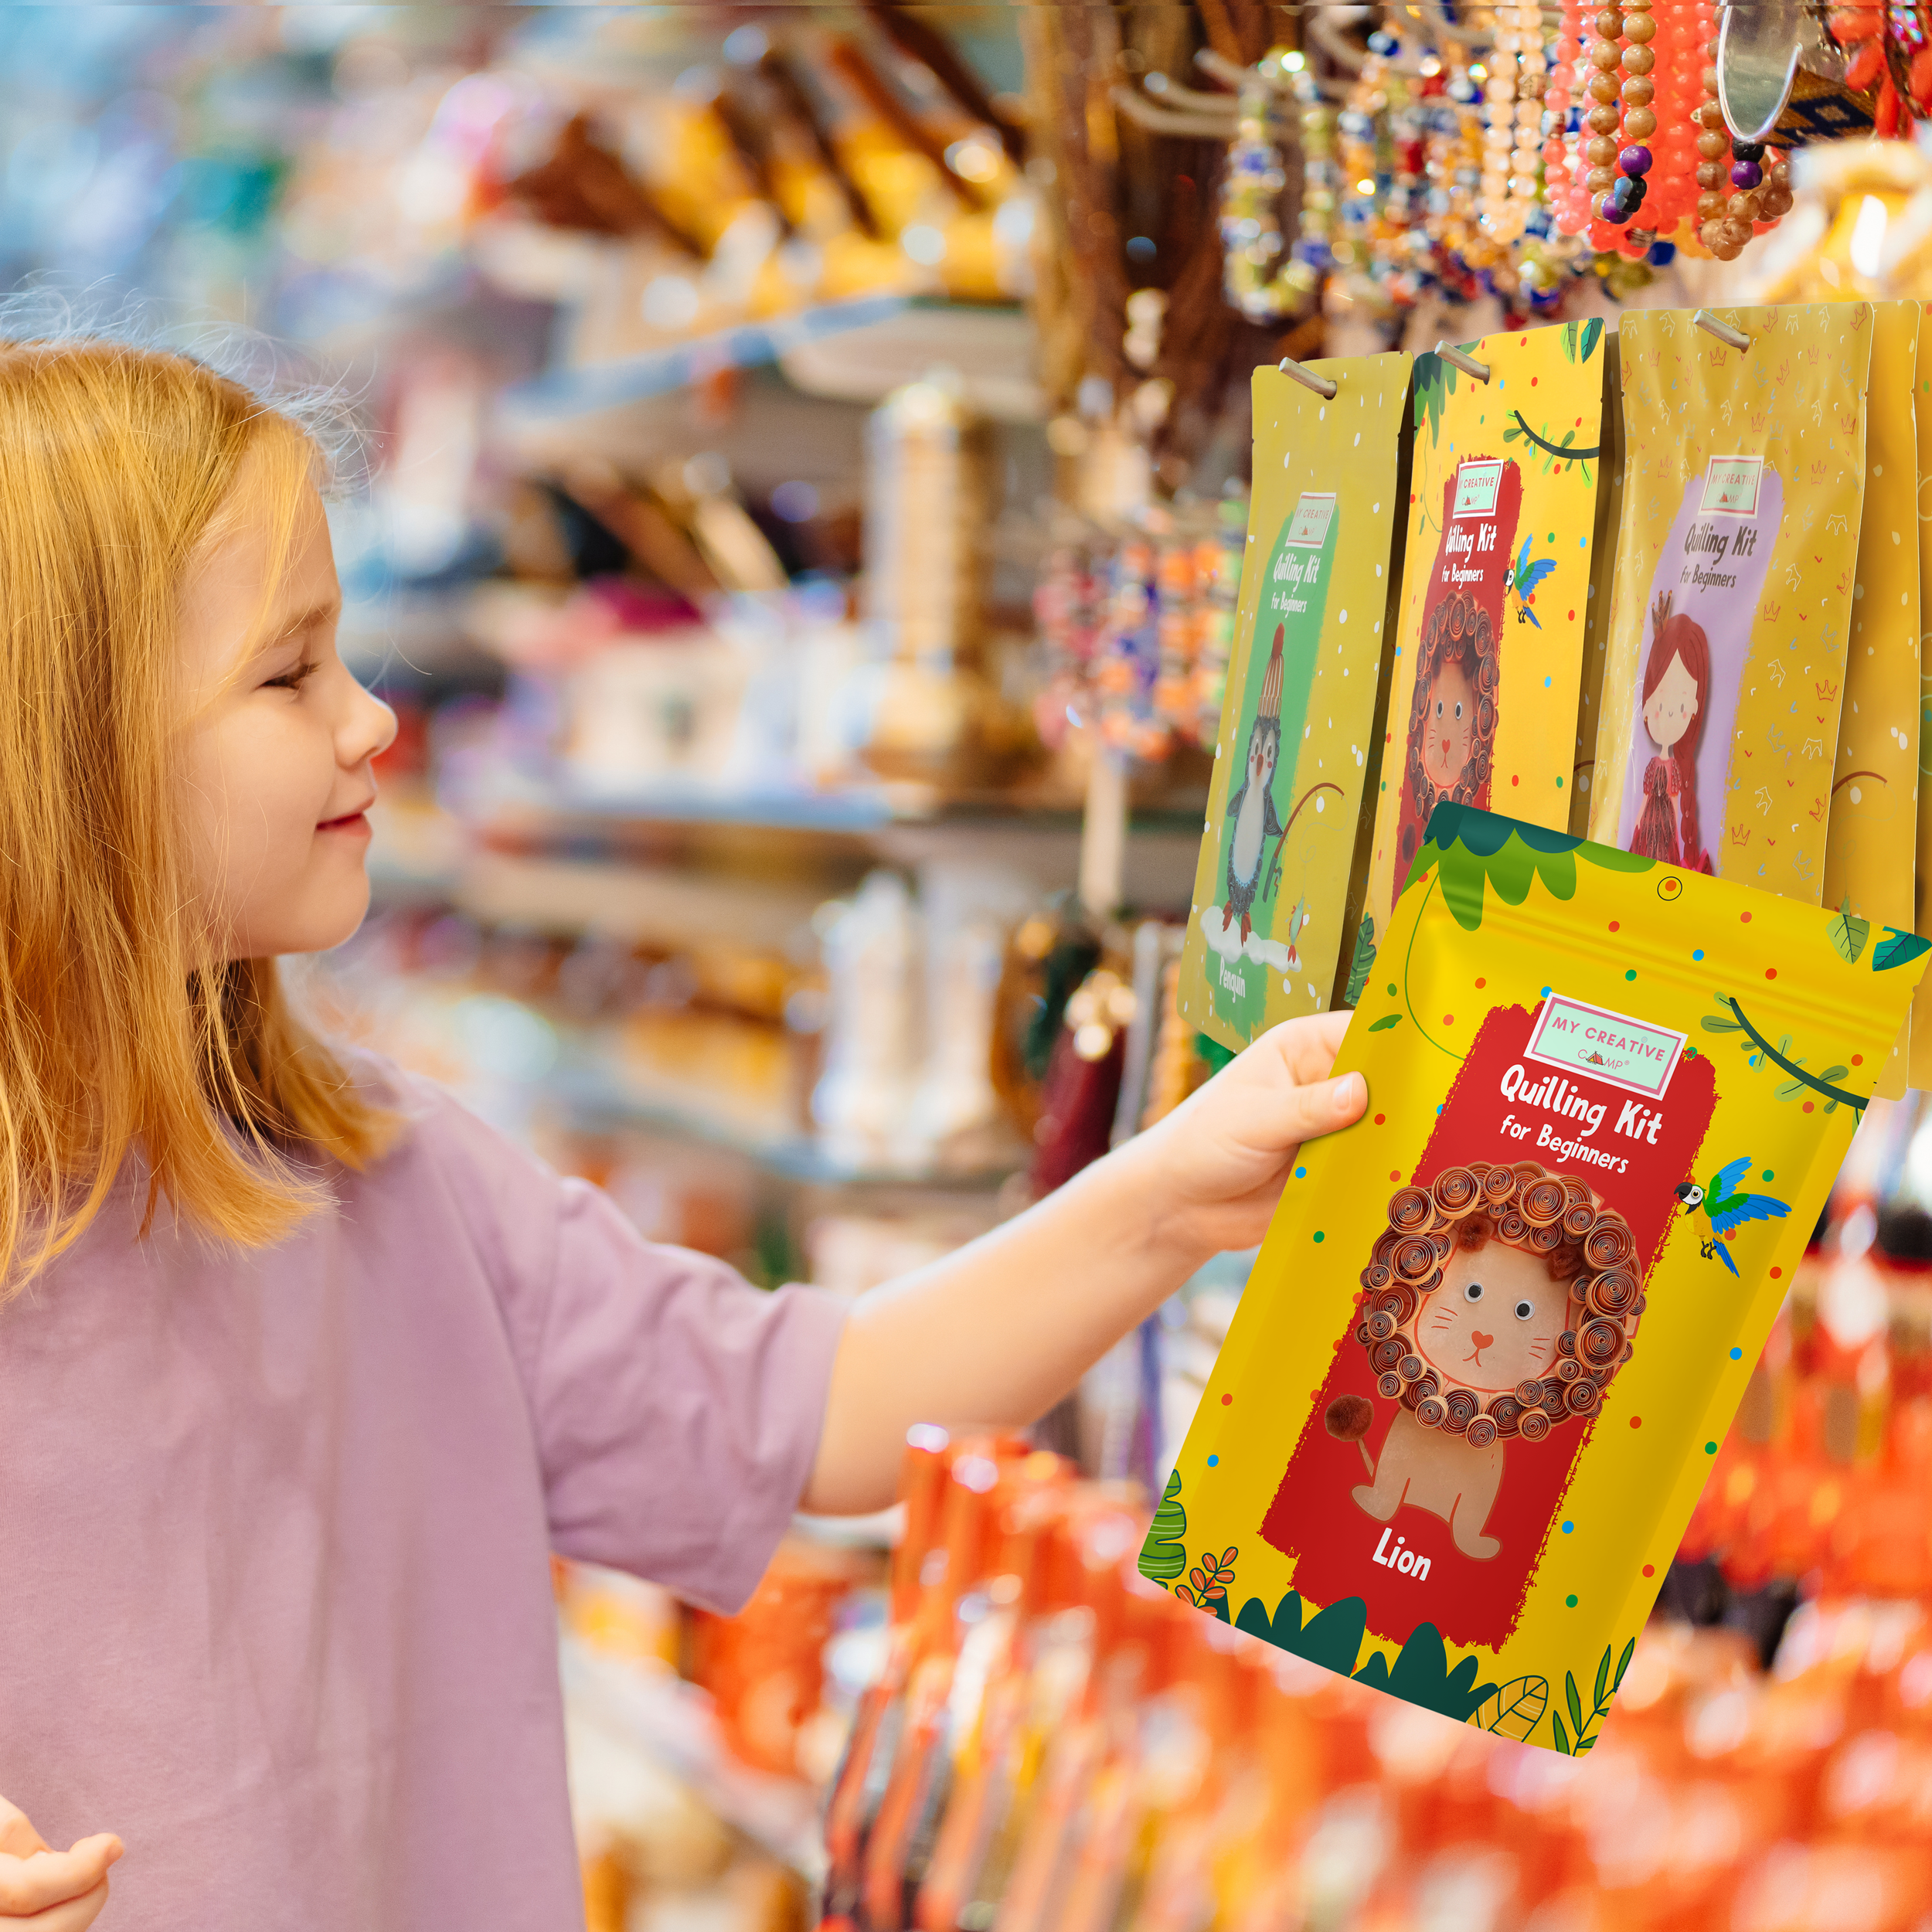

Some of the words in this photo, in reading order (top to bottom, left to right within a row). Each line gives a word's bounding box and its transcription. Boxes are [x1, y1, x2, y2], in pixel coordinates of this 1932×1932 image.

[1464, 477, 1495, 488] CREATIVE
[1711, 474, 1722, 485] MY
[1722, 473, 1756, 485] CREATIVE
[1303, 509, 1329, 519] CREATIVE
[1477, 523, 1497, 552] Kit
[1685, 522, 1730, 566] Quilling
[1731, 526, 1757, 556] Kit
[1274, 553, 1304, 593] Quilling
[1303, 554, 1321, 583] Kit
[1441, 565, 1450, 583] for
[1451, 563, 1484, 590] Beginners
[1680, 565, 1692, 583] for
[1692, 563, 1736, 593] Beginners
[1271, 592, 1280, 609] for
[1280, 591, 1307, 618] Beginners
[1219, 955, 1245, 1003] Penguin
[1552, 1017, 1580, 1033] MY
[1585, 1027, 1665, 1062] CREATIVE
[1500, 1064, 1607, 1137] Quilling
[1614, 1099, 1663, 1145] Kit
[1500, 1114, 1531, 1140] for
[1536, 1124, 1629, 1174] Beginners
[1372, 1527, 1431, 1581] Lion
